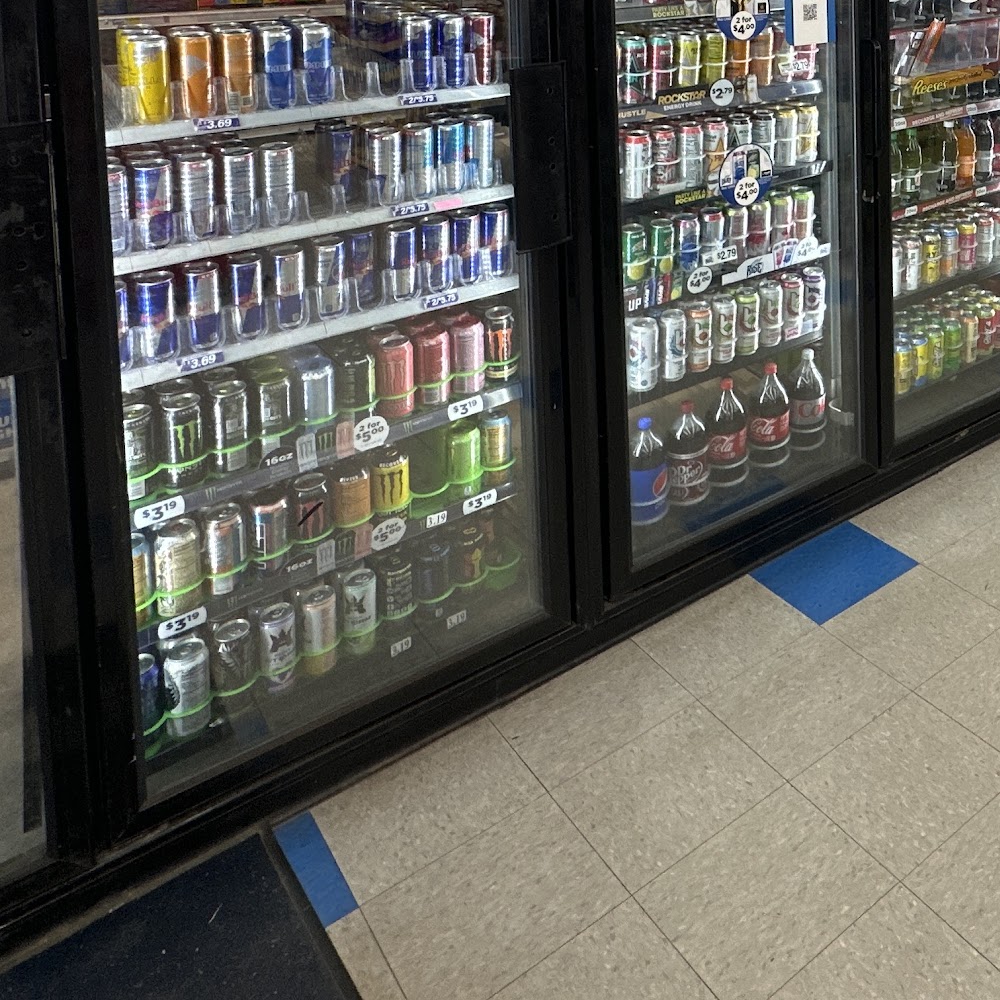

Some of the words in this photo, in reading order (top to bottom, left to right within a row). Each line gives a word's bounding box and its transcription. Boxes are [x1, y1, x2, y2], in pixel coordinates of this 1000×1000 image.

[658, 91, 706, 105] ROCKSTAR
[628, 298, 641, 311] UP
[367, 421, 380, 429] for
[265, 452, 293, 466] 16oz
[428, 514, 446, 527] 3.19
[286, 557, 313, 572] 16oz
